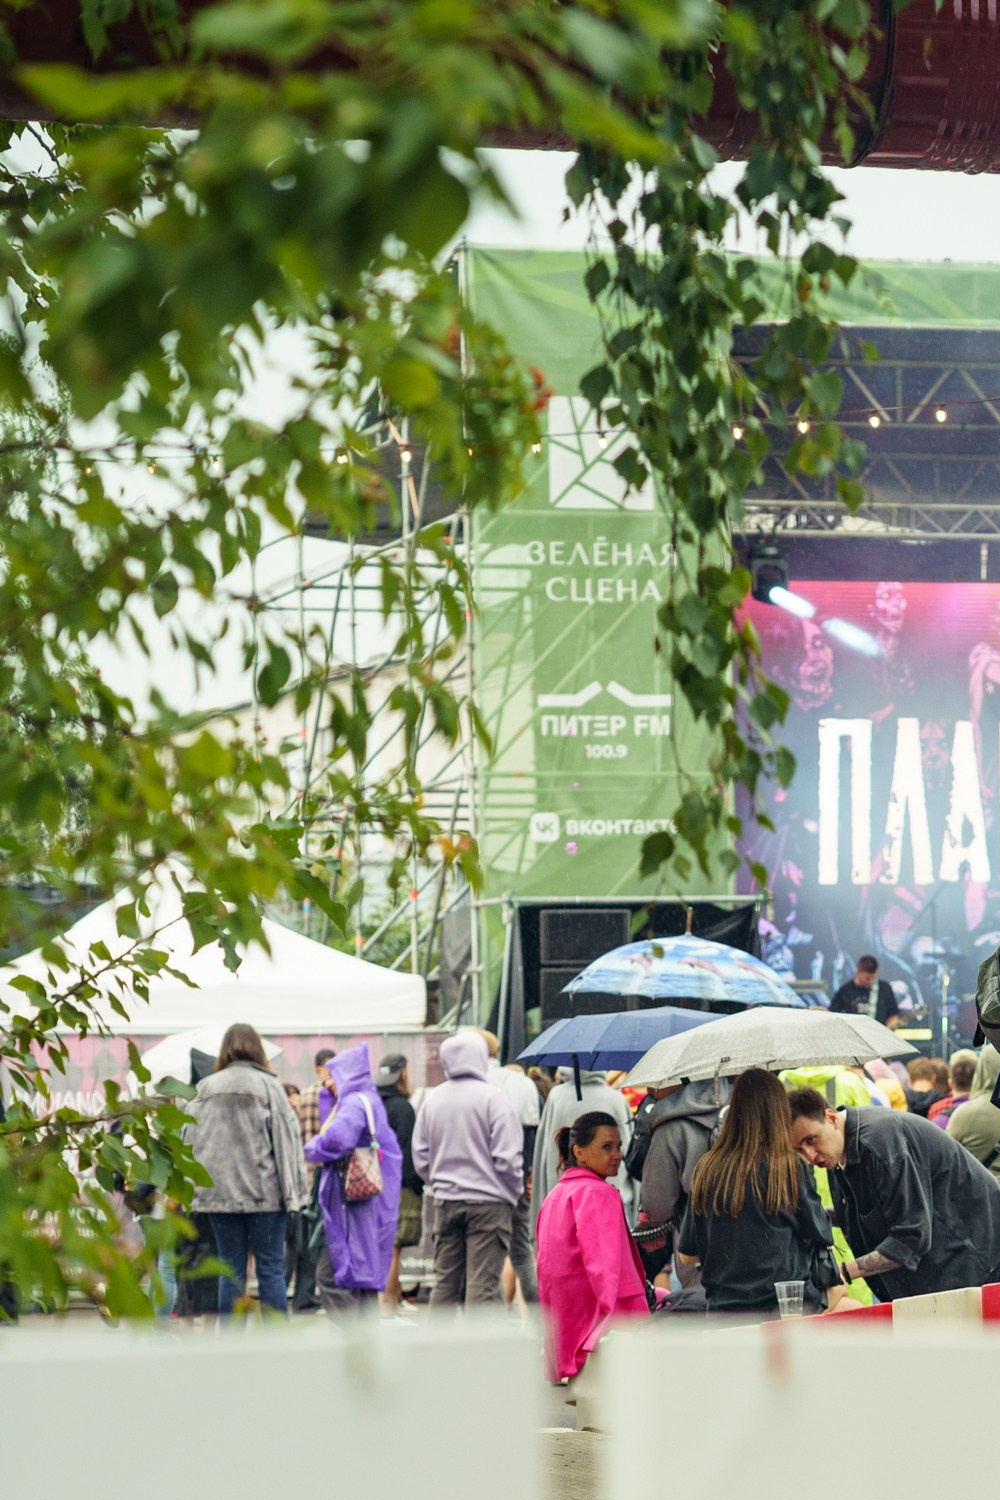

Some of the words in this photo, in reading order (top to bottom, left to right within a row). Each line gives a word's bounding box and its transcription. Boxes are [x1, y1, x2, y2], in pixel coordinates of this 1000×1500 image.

[527, 536, 679, 567] ЗЕЛЁНАЯ
[545, 575, 663, 605] СЦЕНА
[540, 714, 627, 737] ПИТЕР
[633, 714, 670, 737] FM
[585, 743, 628, 759] 100.9
